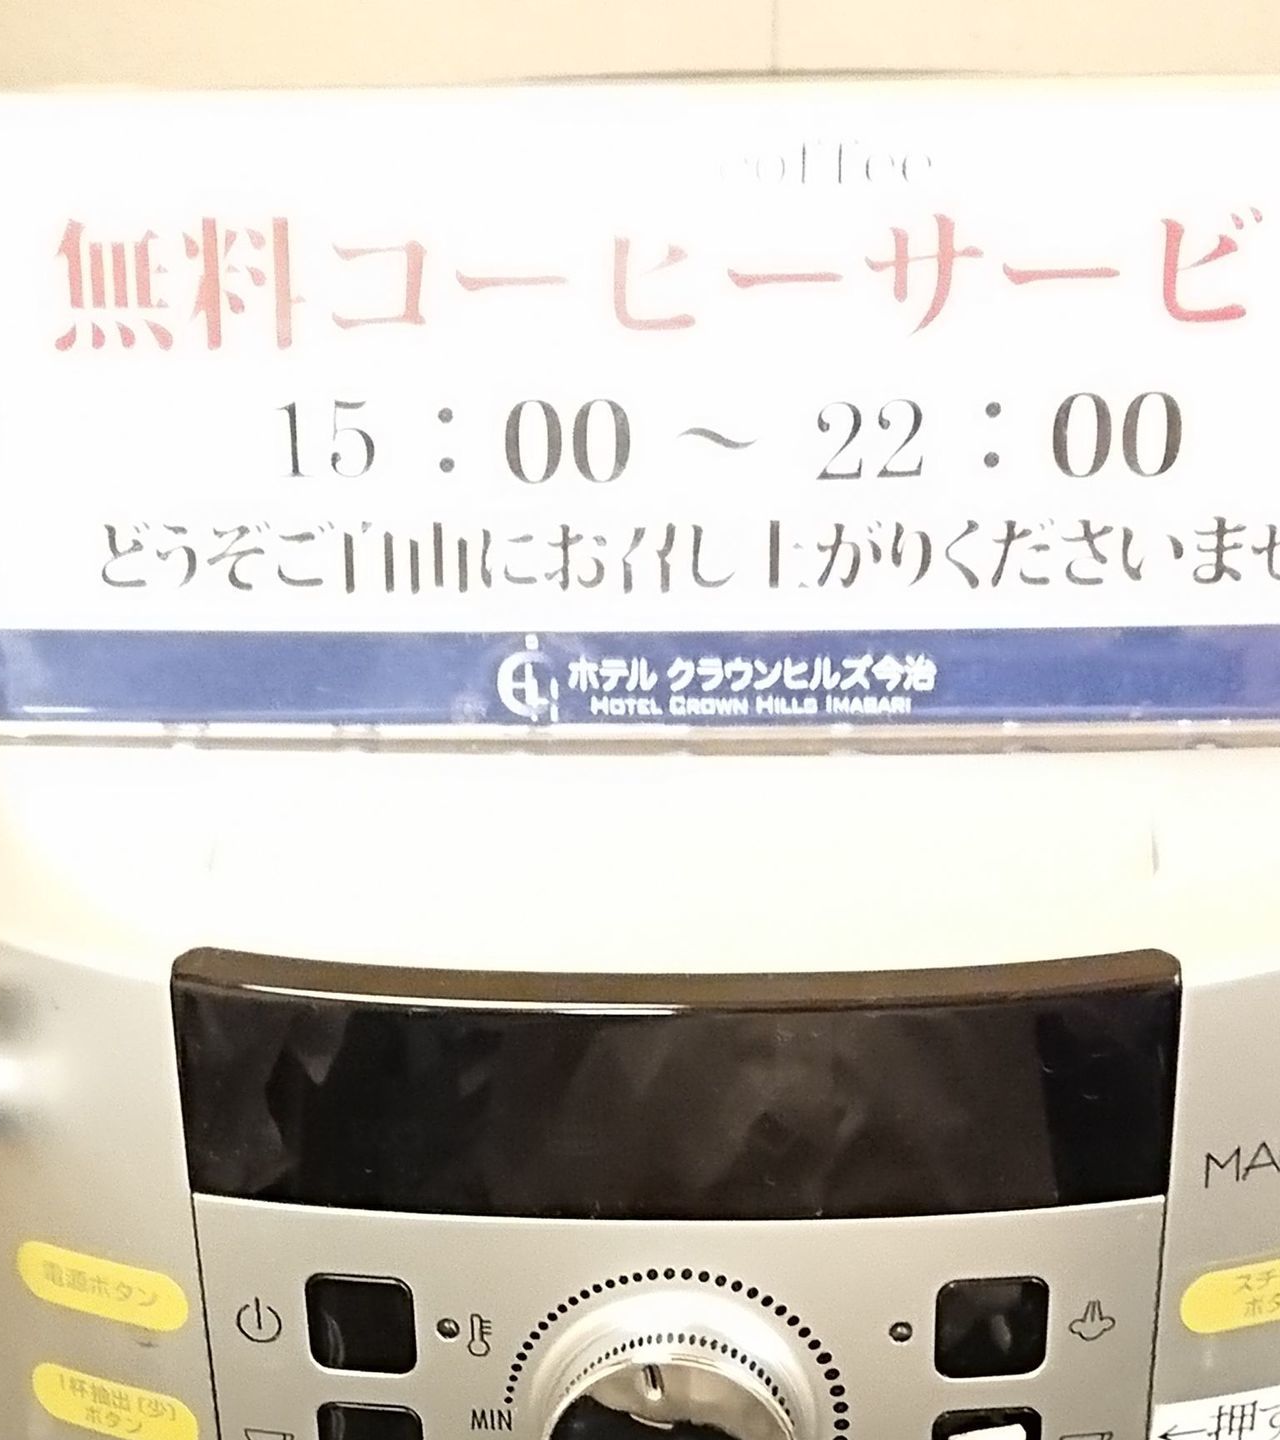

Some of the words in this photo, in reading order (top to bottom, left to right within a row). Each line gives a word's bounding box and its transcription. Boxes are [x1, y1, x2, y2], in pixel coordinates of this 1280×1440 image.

[568, 656, 657, 692] ホテル
[667, 654, 937, 692] クラウンヒルズ今治
[590, 696, 664, 716] HOTEL
[670, 696, 750, 716] CROWN
[756, 696, 819, 715] HILLS
[826, 694, 912, 715] IMABARI
[42, 1259, 160, 1307] 電源ボタン
[84, 1405, 145, 1434] ボタン
[470, 1408, 513, 1431] MIN
